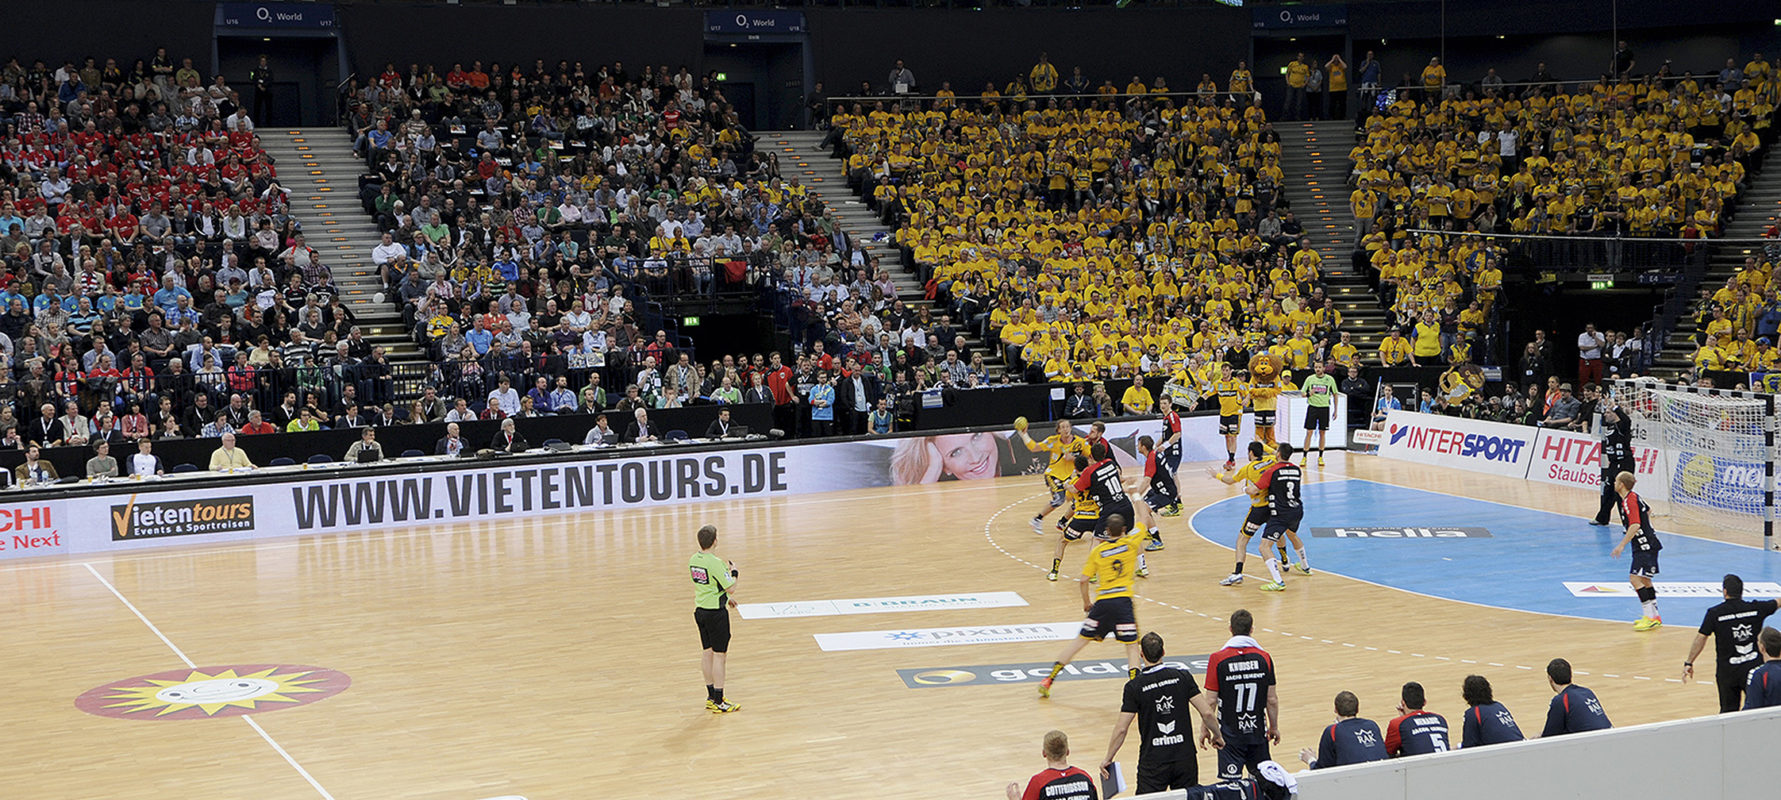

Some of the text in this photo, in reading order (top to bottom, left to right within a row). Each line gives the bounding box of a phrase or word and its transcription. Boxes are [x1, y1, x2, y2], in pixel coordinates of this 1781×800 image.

[277, 13, 302, 21] World
[753, 19, 775, 27] World
[1407, 426, 1526, 464] INTERSPORT
[1542, 436, 1659, 474] HITAHI
[292, 451, 787, 530] WWW.VIETENTOURS.DE
[134, 526, 172, 536] Events
[186, 520, 250, 533] Sportreisen
[1335, 527, 1467, 539] hella
[12, 530, 61, 550] Next
[931, 626, 1053, 640] pixum
[1732, 628, 1754, 639] RAK
[990, 658, 1209, 681] goldas
[1228, 660, 1259, 672] KNUDSEN
[1156, 699, 1175, 712] RAK
[1238, 719, 1258, 730] RAK
[1152, 733, 1185, 746] erima
[1357, 731, 1377, 745] RAK
[1429, 733, 1448, 753] 5
